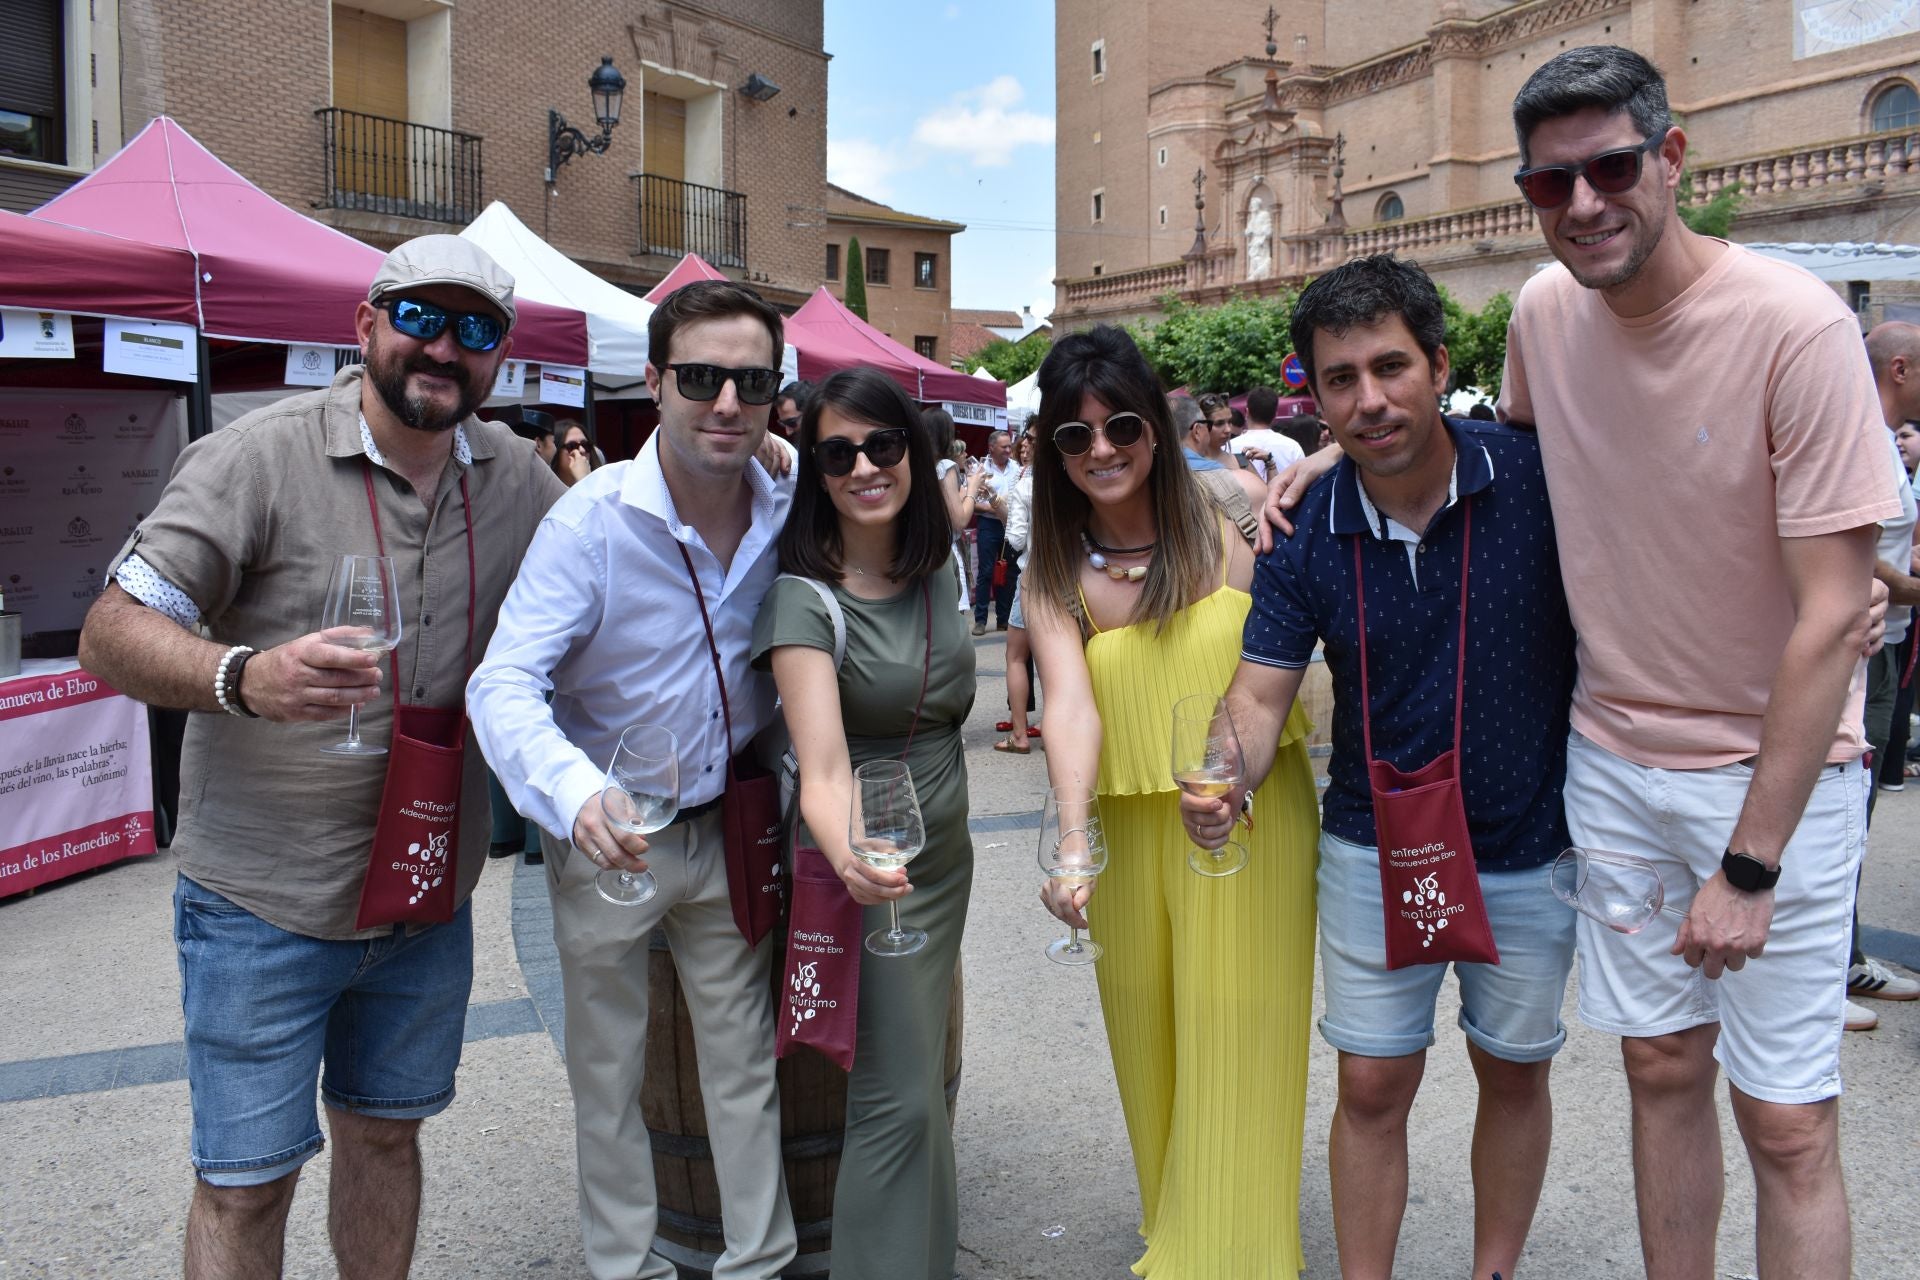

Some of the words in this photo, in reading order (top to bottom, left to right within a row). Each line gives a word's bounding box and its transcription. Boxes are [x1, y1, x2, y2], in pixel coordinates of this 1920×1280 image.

[0, 690, 45, 710] anueva
[47, 682, 64, 700] de
[65, 678, 97, 696] Ebro
[23, 761, 33, 774] de
[35, 759, 42, 771] la
[43, 753, 65, 768] lluvia
[66, 750, 88, 762] nace
[89, 745, 98, 757] la
[17, 775, 31, 790] del
[56, 767, 70, 778] las
[23, 853, 39, 871] de
[41, 849, 60, 865] los
[62, 831, 120, 859] Remedios
[1391, 842, 1445, 858] enTreviñas
[1429, 855, 1441, 863] de
[1440, 850, 1456, 860] Ebro
[1400, 903, 1465, 920] enoTurismo
[827, 946, 844, 954] Ebro
